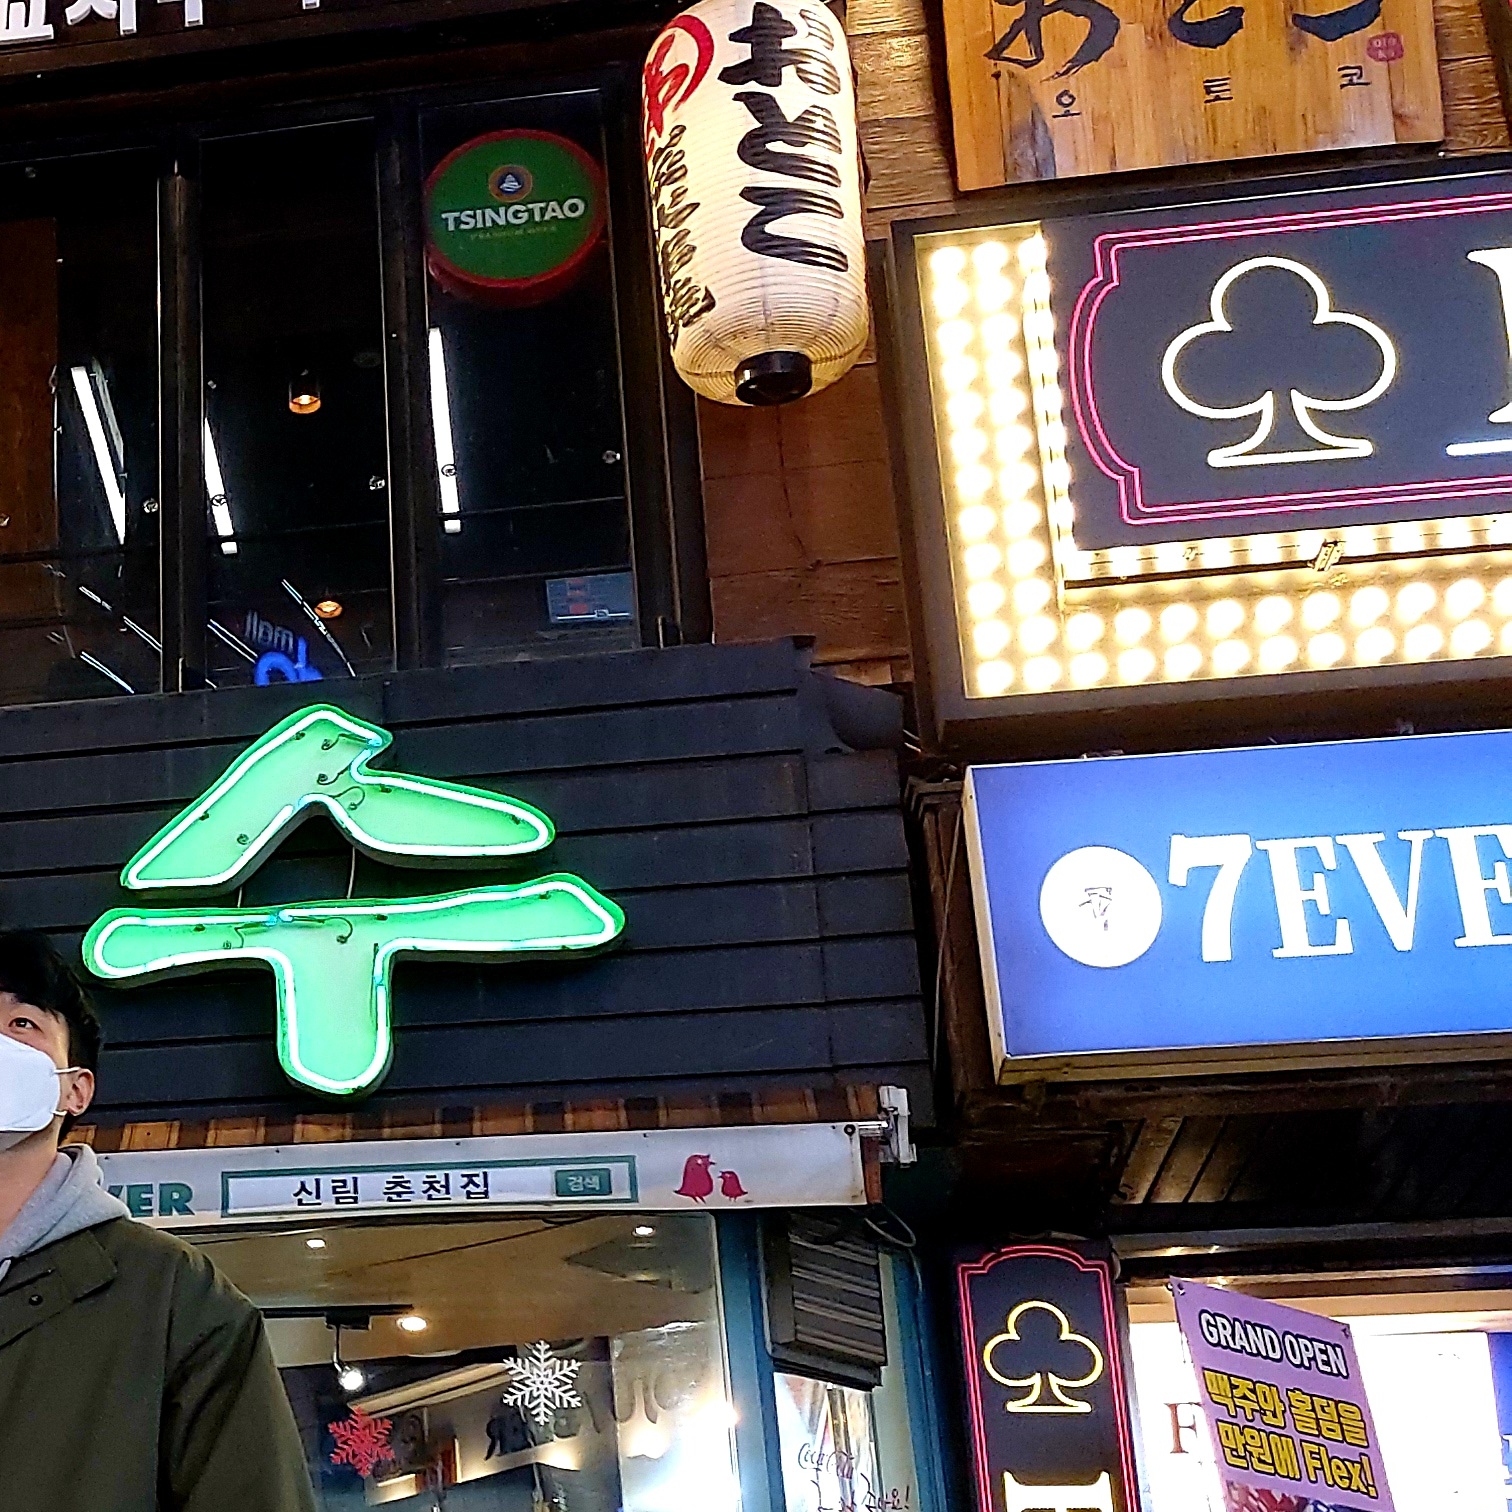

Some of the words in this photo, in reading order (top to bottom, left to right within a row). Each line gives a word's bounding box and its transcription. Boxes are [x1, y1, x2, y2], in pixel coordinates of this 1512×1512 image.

[440, 197, 586, 232] TSINGTAO
[292, 1174, 360, 1208] 신림
[381, 1169, 491, 1206] 춘천집
[565, 1174, 601, 1194] 검색
[1199, 1309, 1283, 1364] GRAND
[1285, 1331, 1349, 1379] OPEN
[1203, 1366, 1286, 1429] 맥주와
[1287, 1386, 1369, 1449] 홀덤을
[1217, 1419, 1302, 1481] 만원에
[1301, 1441, 1378, 1499] Flex!
